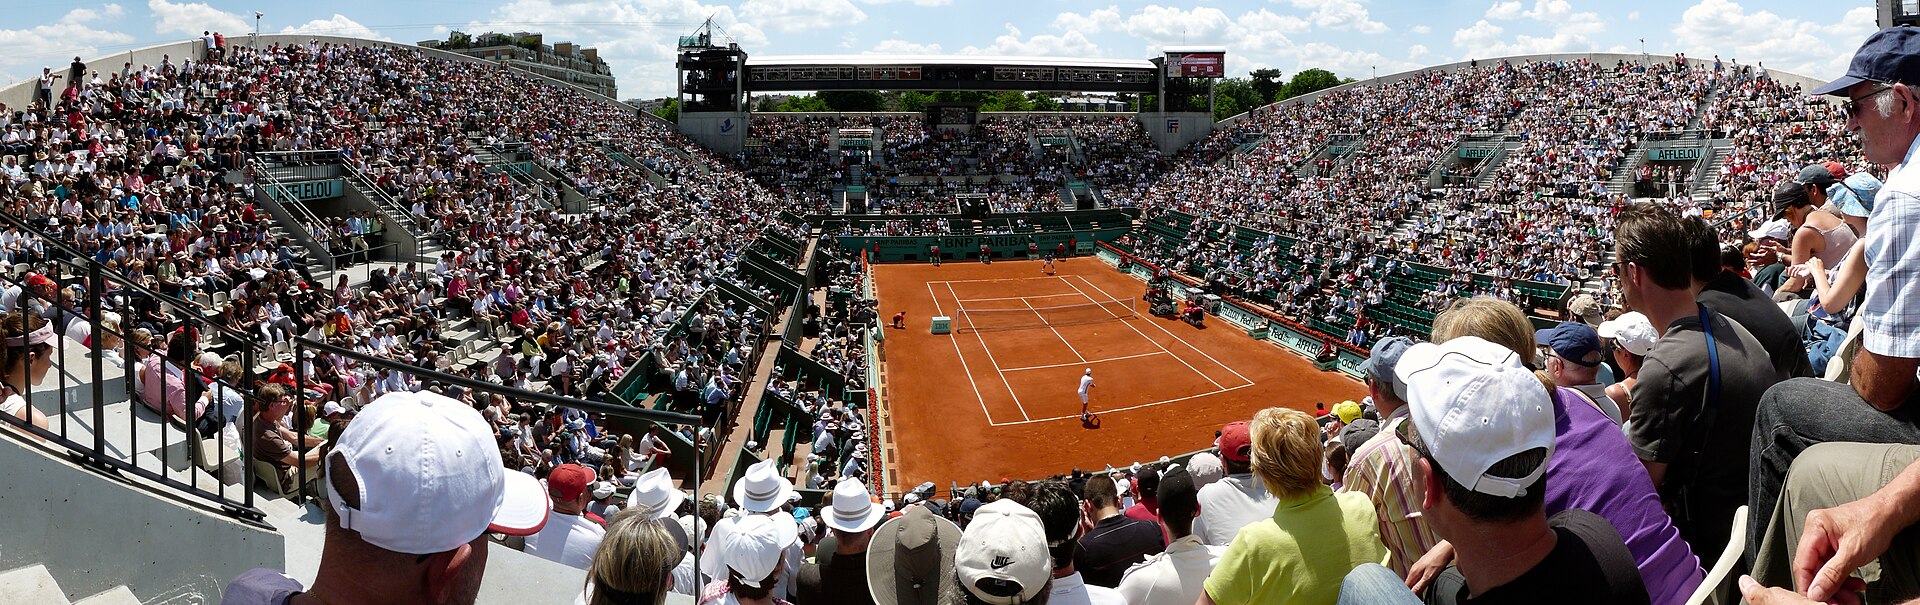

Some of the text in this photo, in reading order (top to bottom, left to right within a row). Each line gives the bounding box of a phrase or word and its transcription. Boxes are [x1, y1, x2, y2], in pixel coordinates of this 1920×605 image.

[1658, 149, 1701, 160] AFFLELOU
[945, 235, 1036, 249] BNP PARIBAS
[935, 322, 949, 330] IBM
[994, 554, 1011, 567] NIKE
